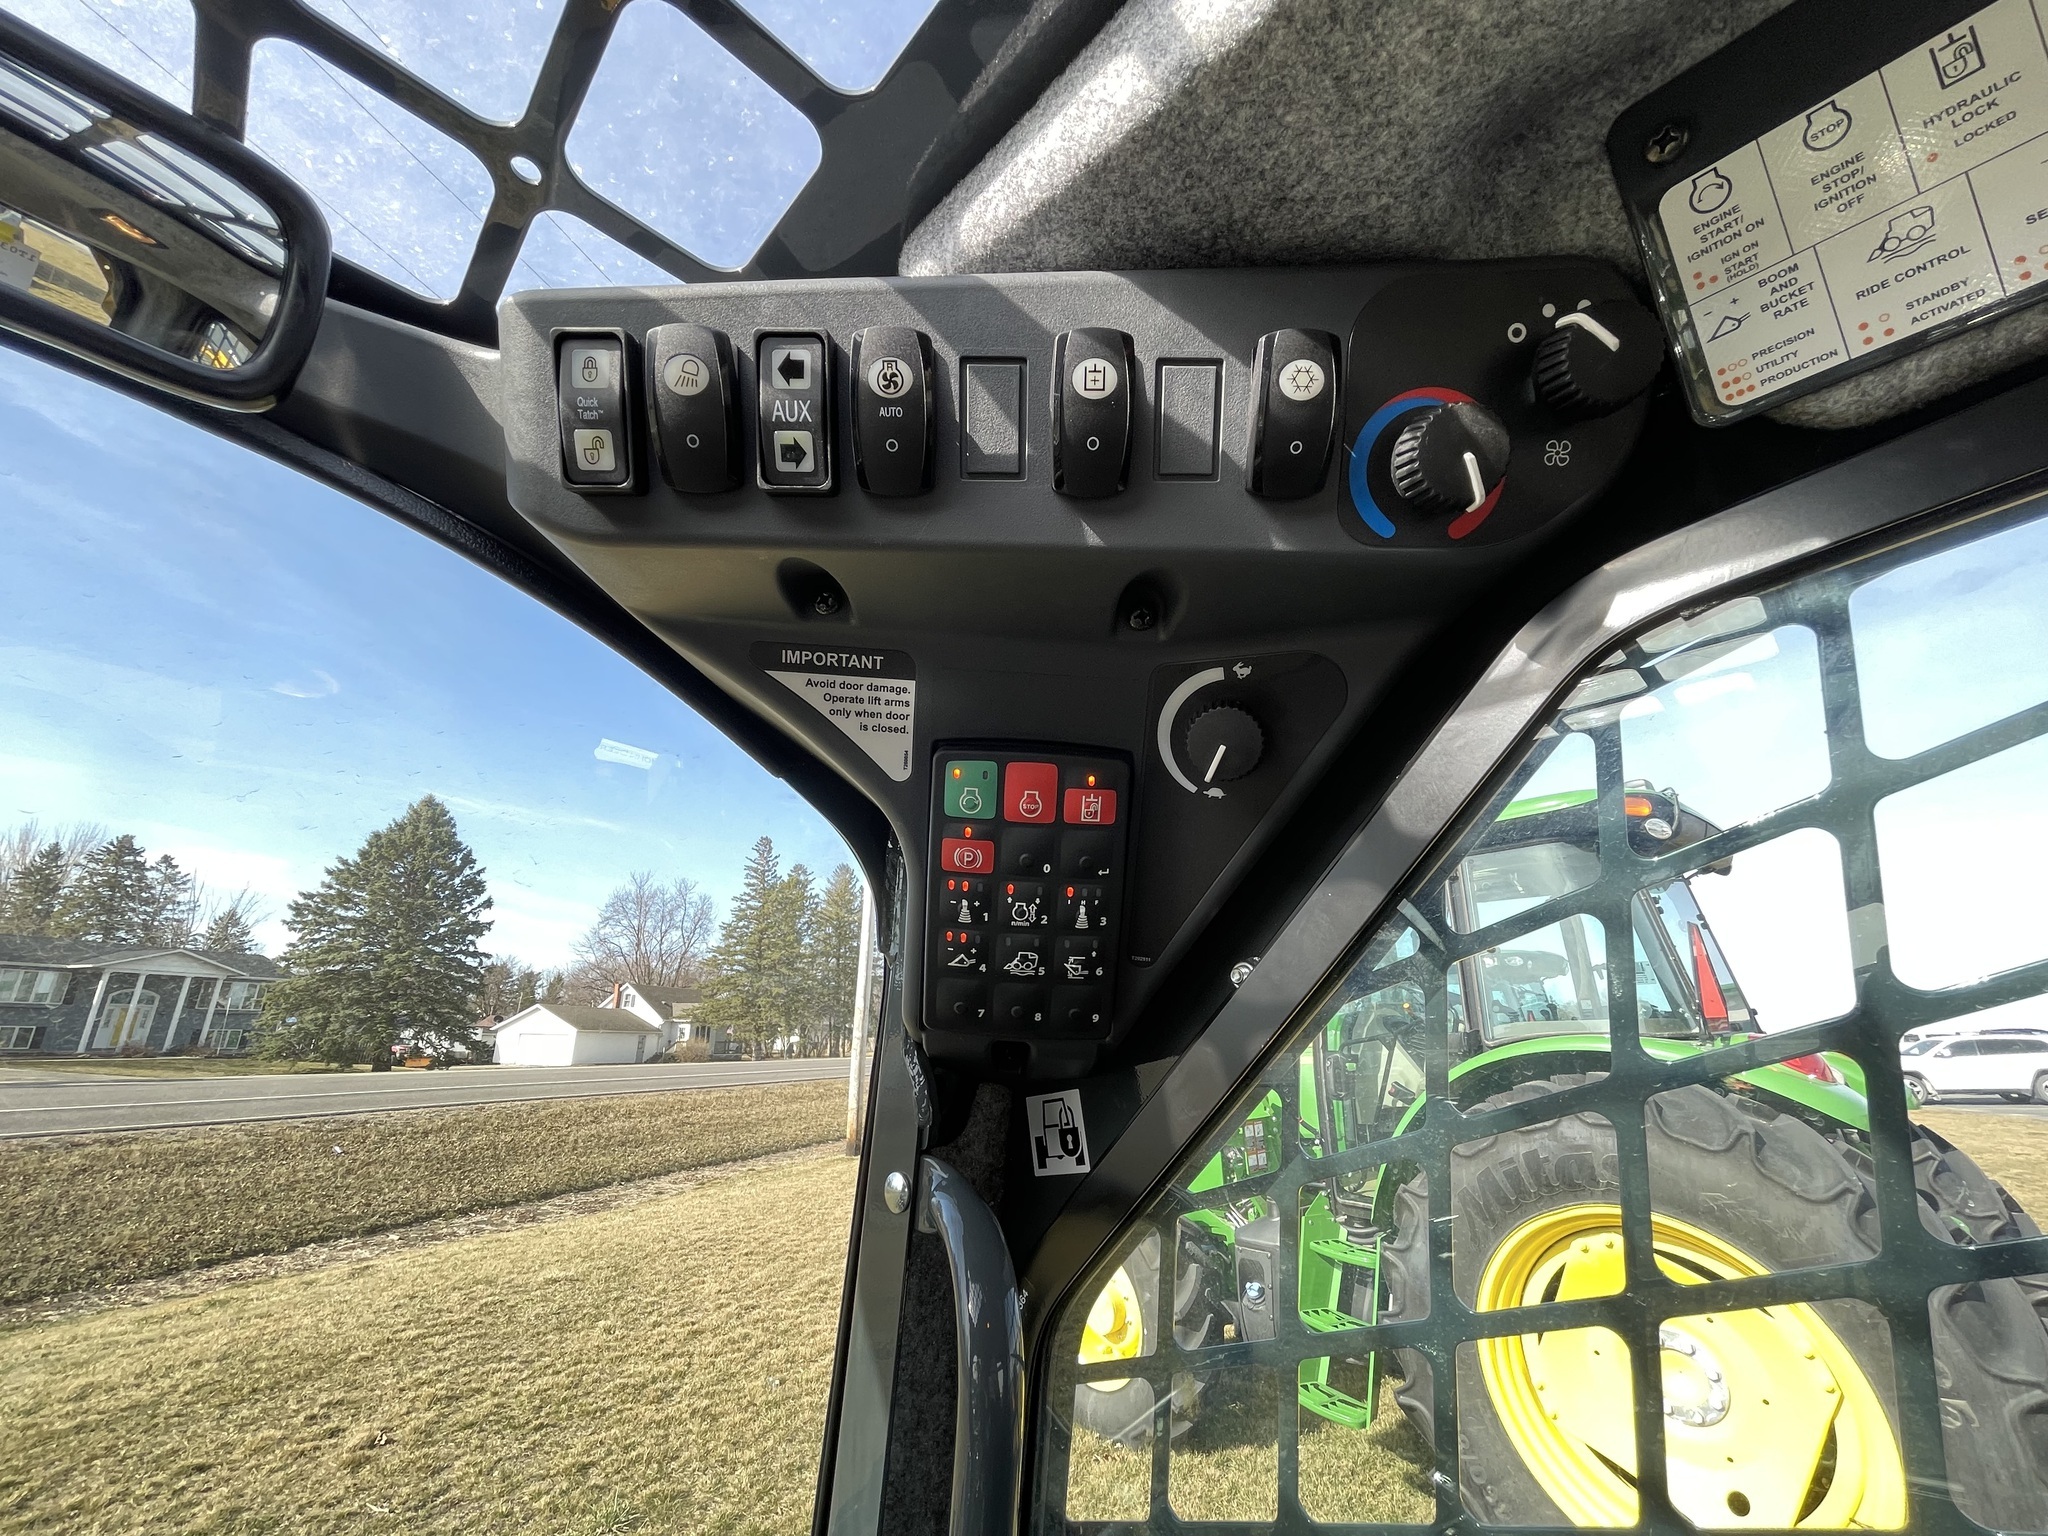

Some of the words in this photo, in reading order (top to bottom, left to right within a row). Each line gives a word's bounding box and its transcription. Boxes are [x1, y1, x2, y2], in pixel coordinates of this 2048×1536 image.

[1922, 71, 2022, 129] HYDRAULIC
[1951, 98, 2000, 129] LOCK
[1810, 118, 1845, 142] STOP
[1954, 110, 2017, 147] LOCKED
[1810, 152, 1865, 186] ENGINE
[1822, 166, 1865, 193] STOP/
[1814, 174, 1877, 211] IGNITION
[1837, 193, 1865, 213] OFF
[1693, 204, 1741, 235] ENGINE
[1699, 215, 1744, 243] START/
[1688, 230, 1742, 263] IGNITION
[1745, 218, 1765, 233] ON
[1721, 250, 1740, 265] IGN
[1742, 240, 1759, 253] ON
[1724, 252, 1759, 275] START
[1726, 263, 1760, 283] (HOLD)
[1856, 279, 1891, 300] RIDE
[1894, 246, 1972, 283] CONTROL
[1758, 263, 1799, 288] BOOM
[1770, 277, 1798, 296] AND
[1905, 277, 1969, 311] STANDBY
[1760, 282, 1815, 313] BUCKET
[1911, 289, 1985, 325] ACTIVATED
[1773, 298, 1809, 319] RATE
[1751, 328, 1815, 360] PRECISION
[1756, 350, 1799, 374] UTILITY
[1760, 349, 1838, 386] PRODUCTION
[576, 397, 598, 410] Quick
[772, 400, 812, 423] AUX
[879, 407, 903, 418] AUTO
[781, 649, 884, 670] IMPORTANT
[805, 678, 836, 689] Avoid
[839, 680, 864, 691] door
[866, 683, 911, 695] damage.
[823, 693, 865, 705] Operate
[868, 696, 881, 705] lift
[884, 699, 910, 708] arms
[829, 708, 851, 719] only
[855, 709, 882, 719] when
[885, 711, 910, 721] door
[859, 722, 869, 732] is
[871, 722, 909, 734] closed.
[1022, 803, 1039, 811] STOP
[963, 851, 973, 865] P
[1043, 864, 1051, 874] 0
[983, 912, 989, 922] 1
[1040, 915, 1048, 925] 2
[1099, 916, 1107, 926] 3
[979, 963, 987, 973] 4
[1038, 967, 1045, 977] 5
[1095, 967, 1103, 977] 6
[978, 1009, 985, 1018] 7
[1034, 1012, 1042, 1022] 8
[1092, 1013, 1099, 1023] 9
